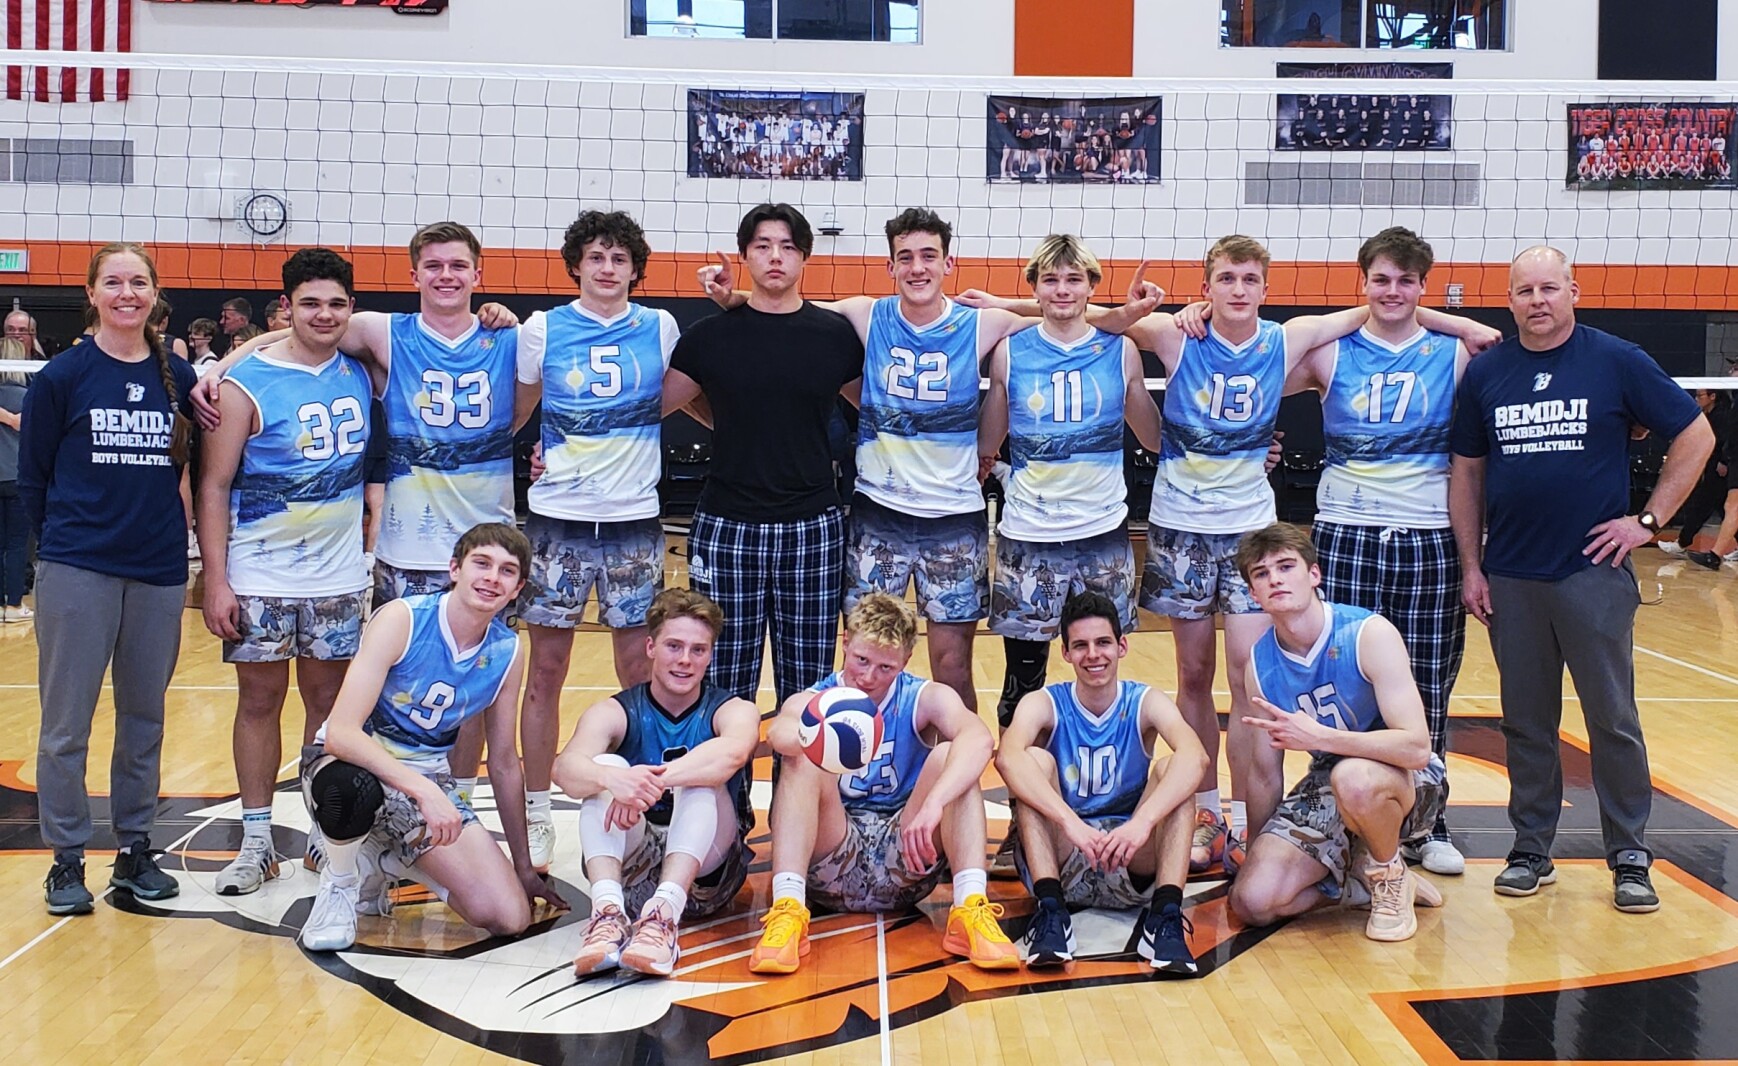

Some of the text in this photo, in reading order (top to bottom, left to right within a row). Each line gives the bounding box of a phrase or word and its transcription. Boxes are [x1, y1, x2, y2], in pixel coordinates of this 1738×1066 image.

[1571, 107, 1736, 136] TIGER CROSS COUNTRY
[589, 344, 622, 398] 5
[886, 345, 948, 402] 22
[1051, 369, 1083, 423] 11
[90, 408, 175, 434] BEMIDJ
[420, 368, 493, 430] 33
[1209, 372, 1257, 423] 13
[1368, 370, 1418, 424] 17
[1494, 398, 1588, 428] BEMIDJI
[92, 432, 172, 449] LUMBERJAC
[297, 396, 366, 461] 32
[1495, 421, 1588, 442] LUMBERJACKS
[1521, 439, 1585, 453] VOLLEYBALL
[92, 452, 119, 464] BOYS
[408, 680, 456, 731] 9
[1296, 682, 1351, 731] 15
[1077, 744, 1117, 799] 10
